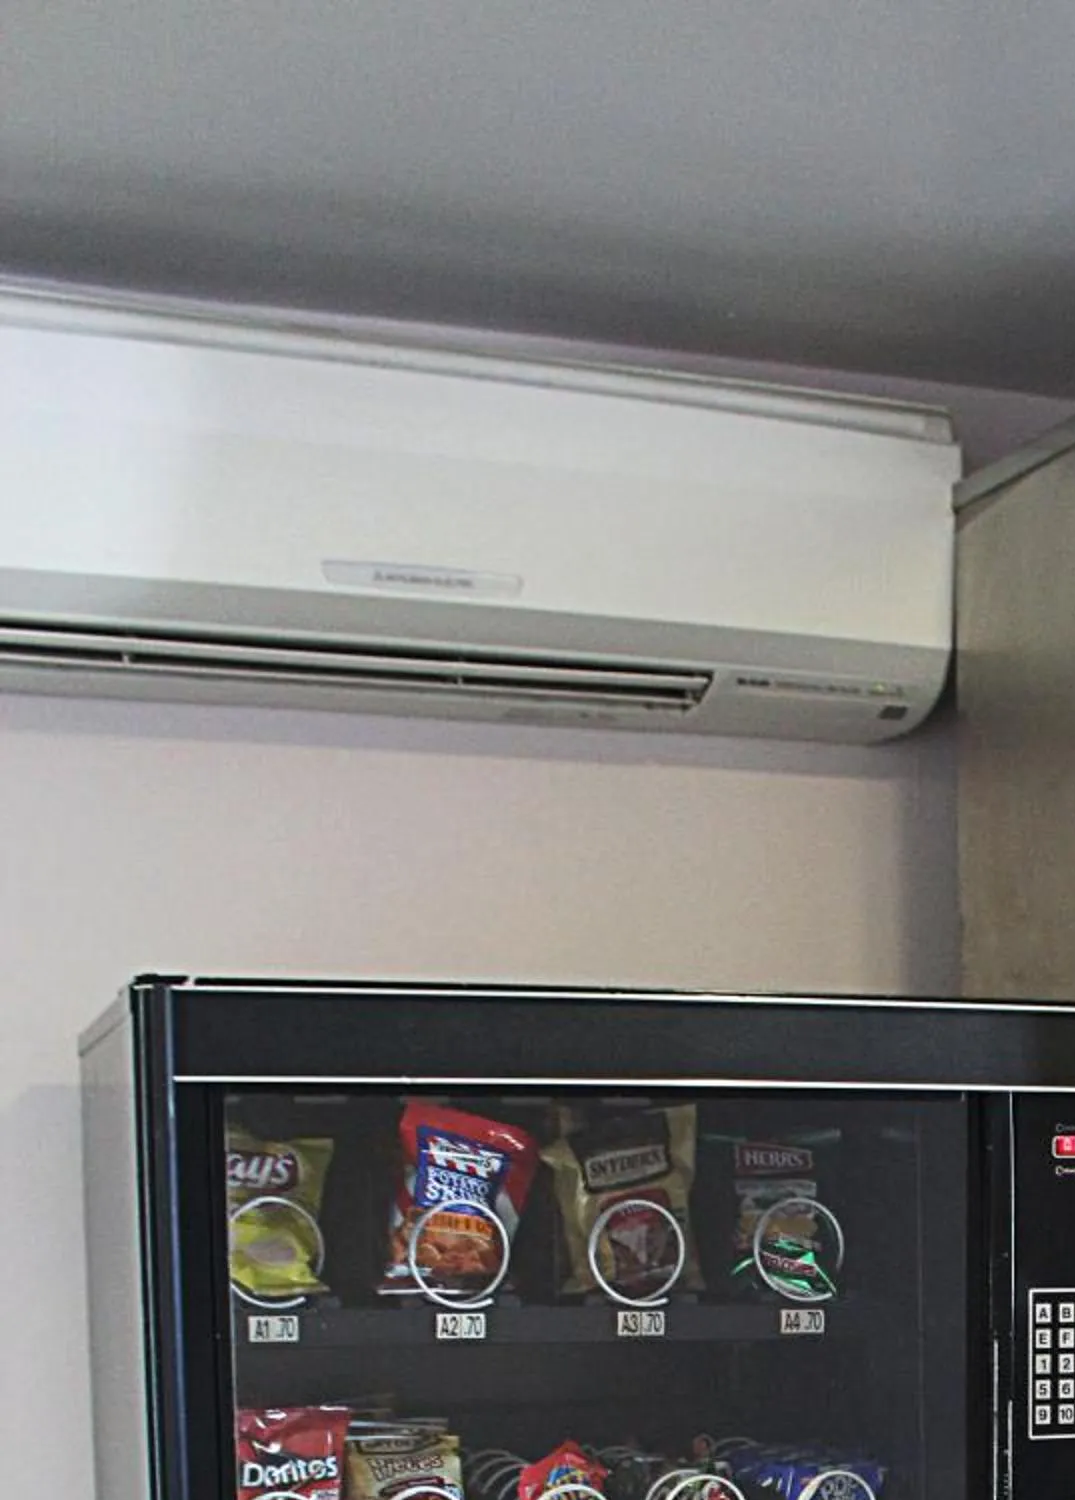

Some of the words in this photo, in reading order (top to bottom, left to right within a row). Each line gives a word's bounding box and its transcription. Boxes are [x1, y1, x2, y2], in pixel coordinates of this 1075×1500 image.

[227, 1153, 294, 1189] ay's
[255, 1319, 270, 1339] A1
[440, 1316, 459, 1337] A2
[621, 1314, 639, 1333] A3
[784, 1312, 801, 1331] A4
[242, 1457, 338, 1488] Doritos
